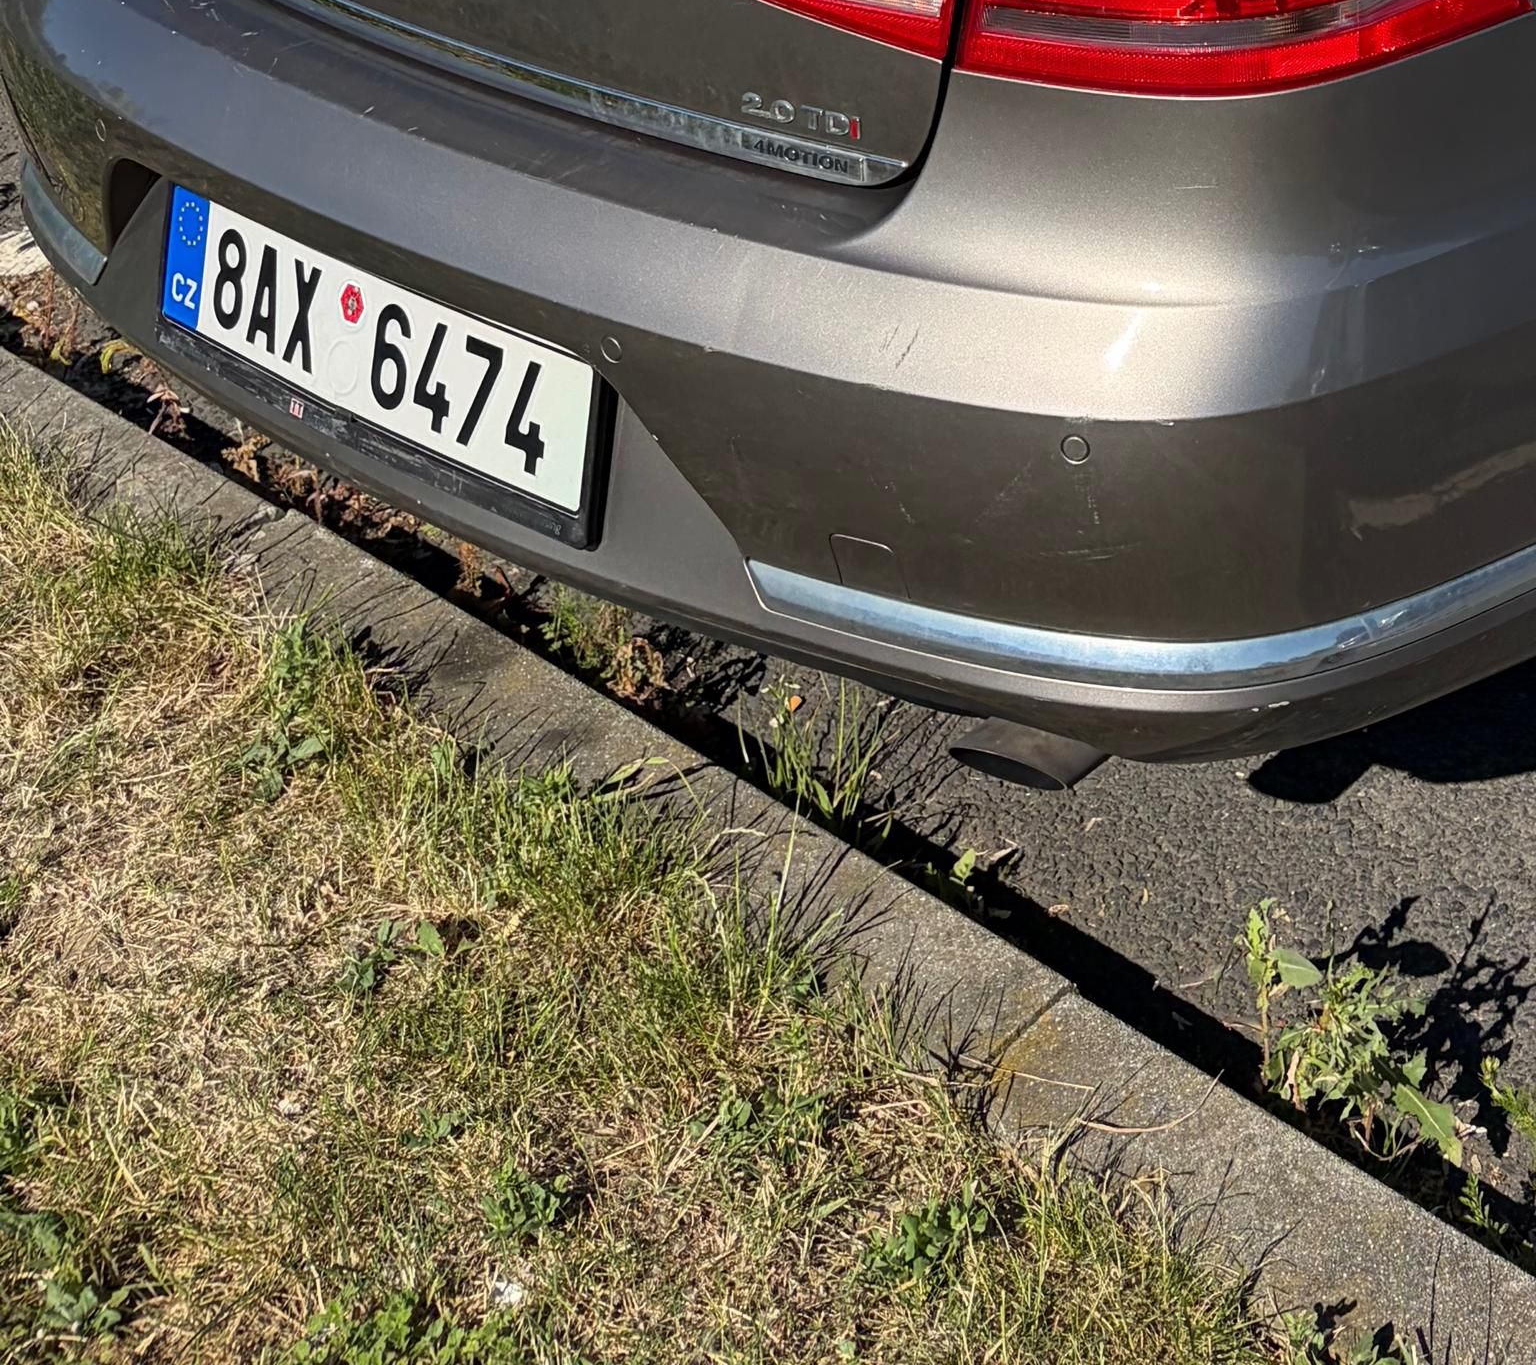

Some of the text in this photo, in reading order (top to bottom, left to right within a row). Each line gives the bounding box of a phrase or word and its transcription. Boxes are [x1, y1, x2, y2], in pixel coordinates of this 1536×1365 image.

[800, 104, 862, 141] TDI
[753, 138, 849, 174] 4MOTION
[170, 271, 198, 311] CZ
[212, 227, 546, 477] 8AX 6474
